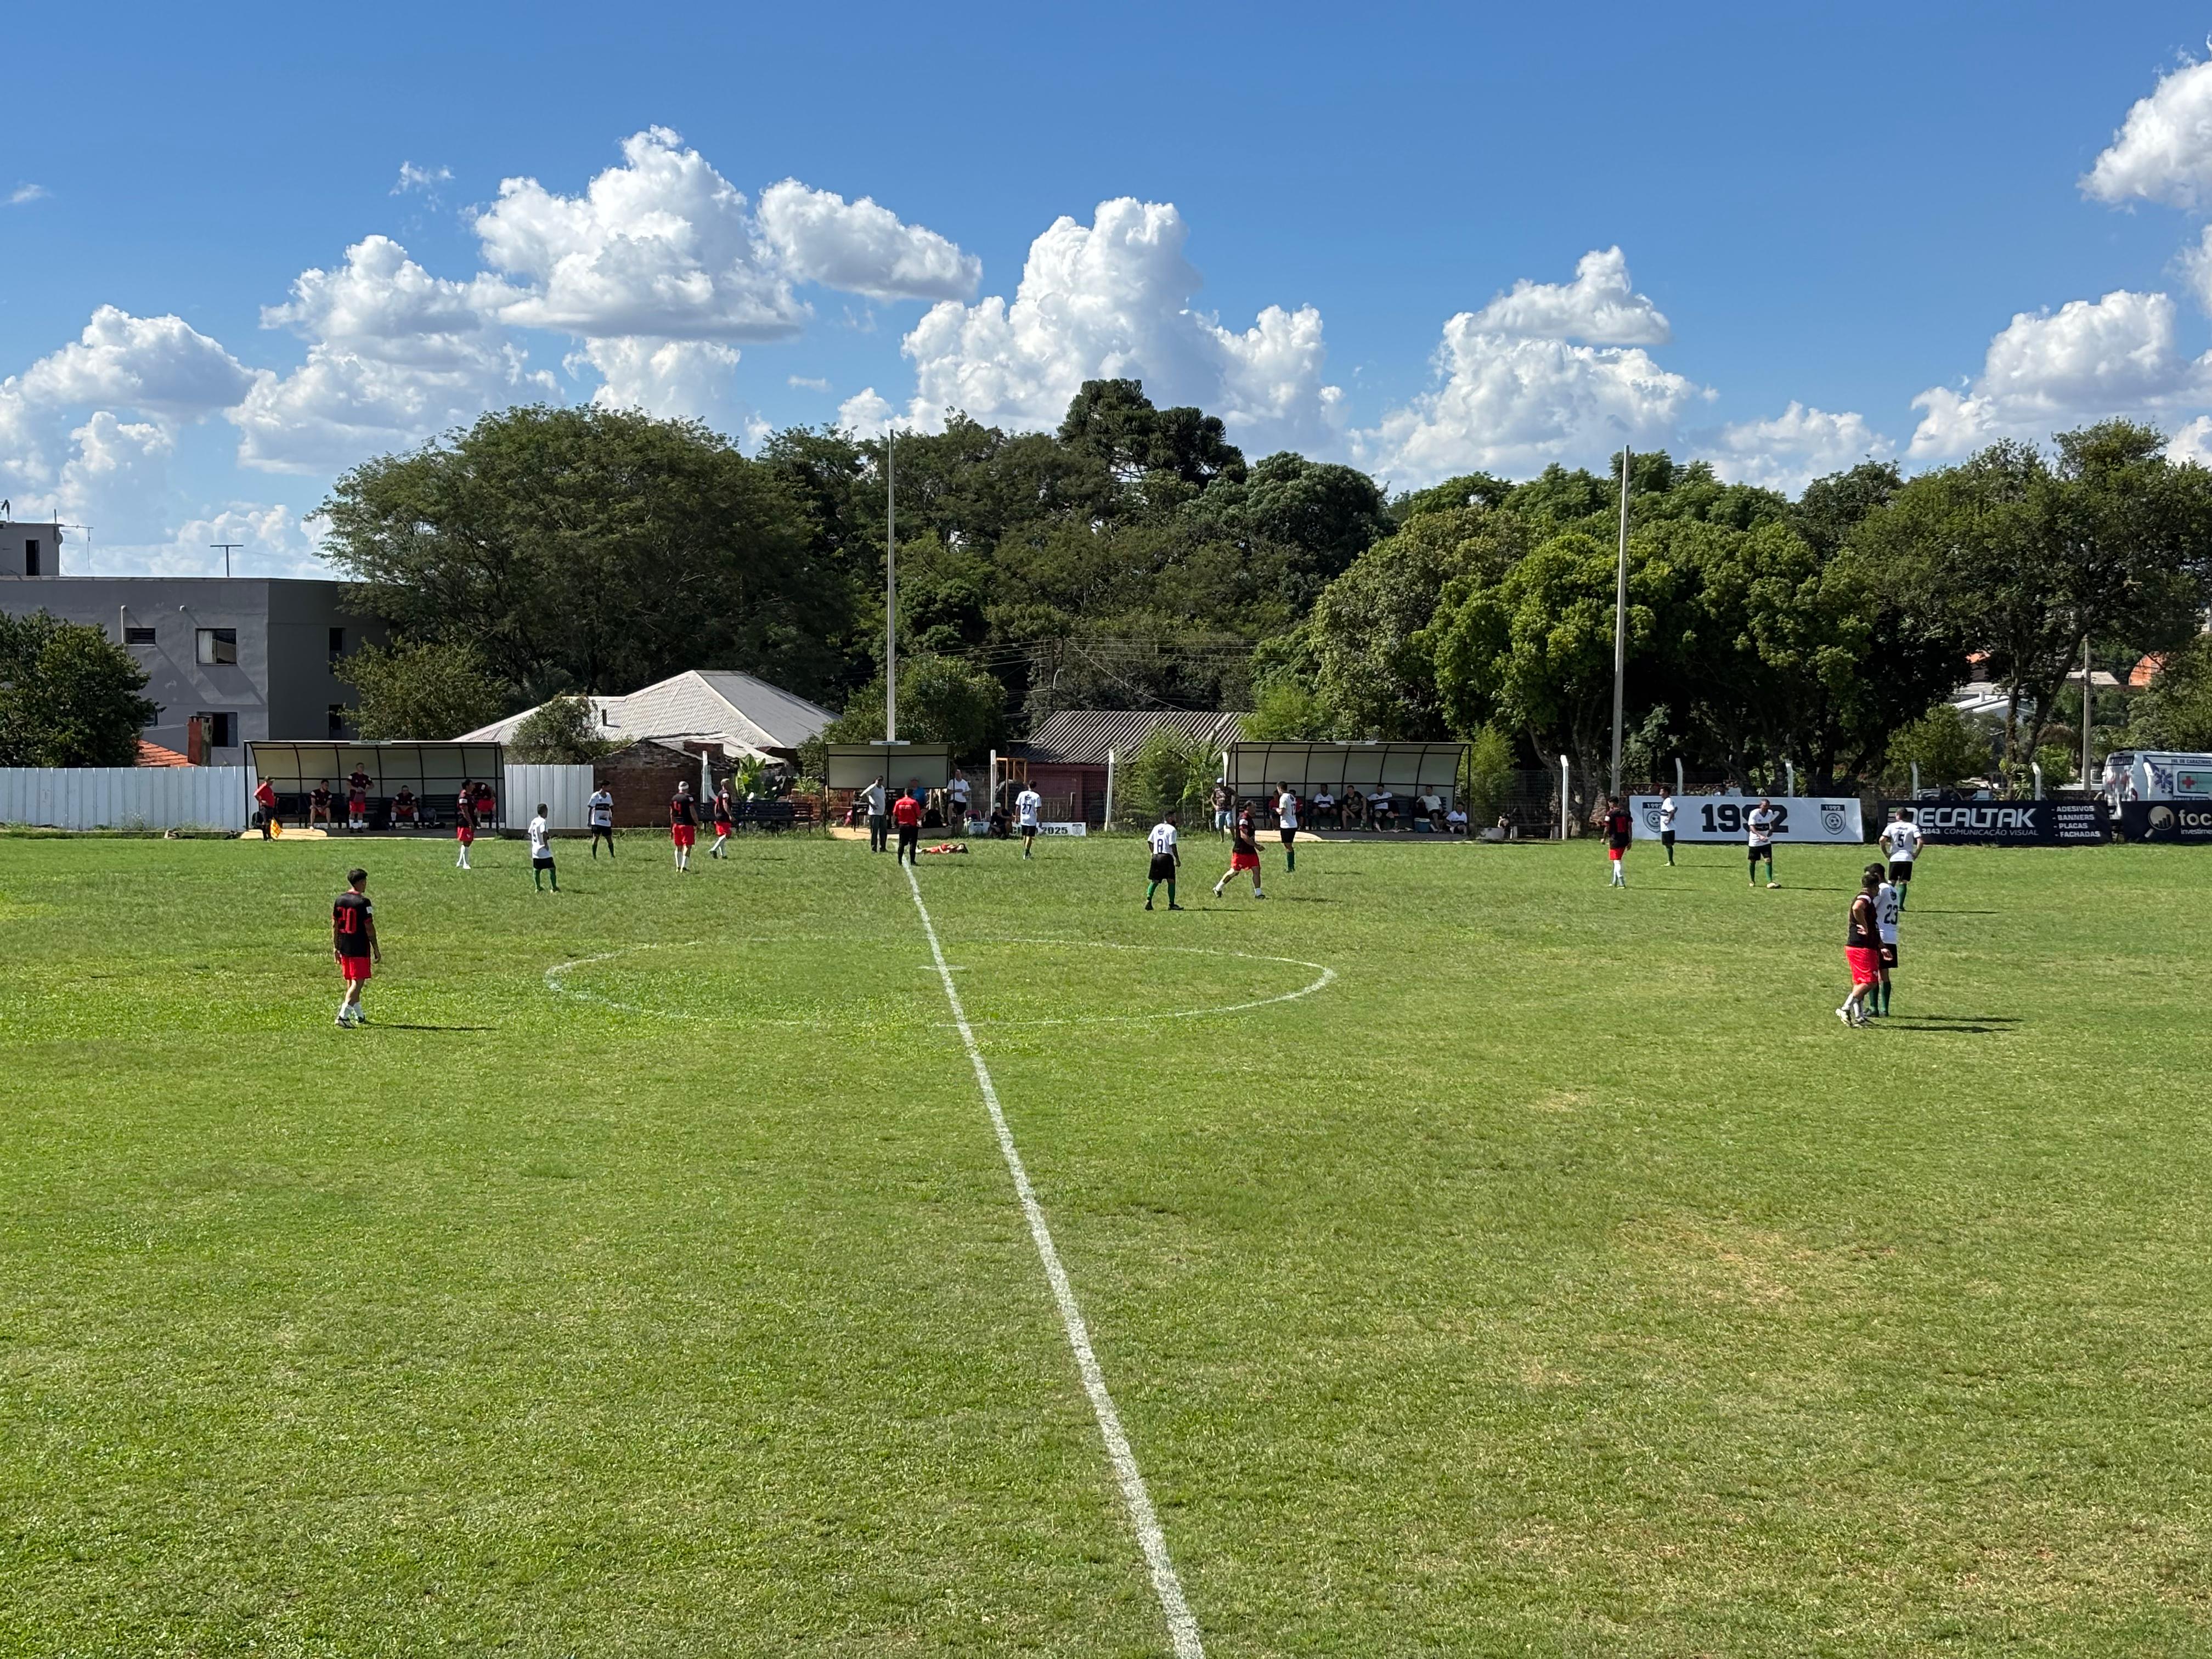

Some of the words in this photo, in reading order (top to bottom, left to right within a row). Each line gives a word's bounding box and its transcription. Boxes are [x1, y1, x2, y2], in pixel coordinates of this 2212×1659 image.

[1022, 803, 1032, 815] 27
[1944, 828, 2007, 836] COMUNICAÇÃO
[1898, 834, 1905, 848] 5
[1883, 904, 1898, 925] 23
